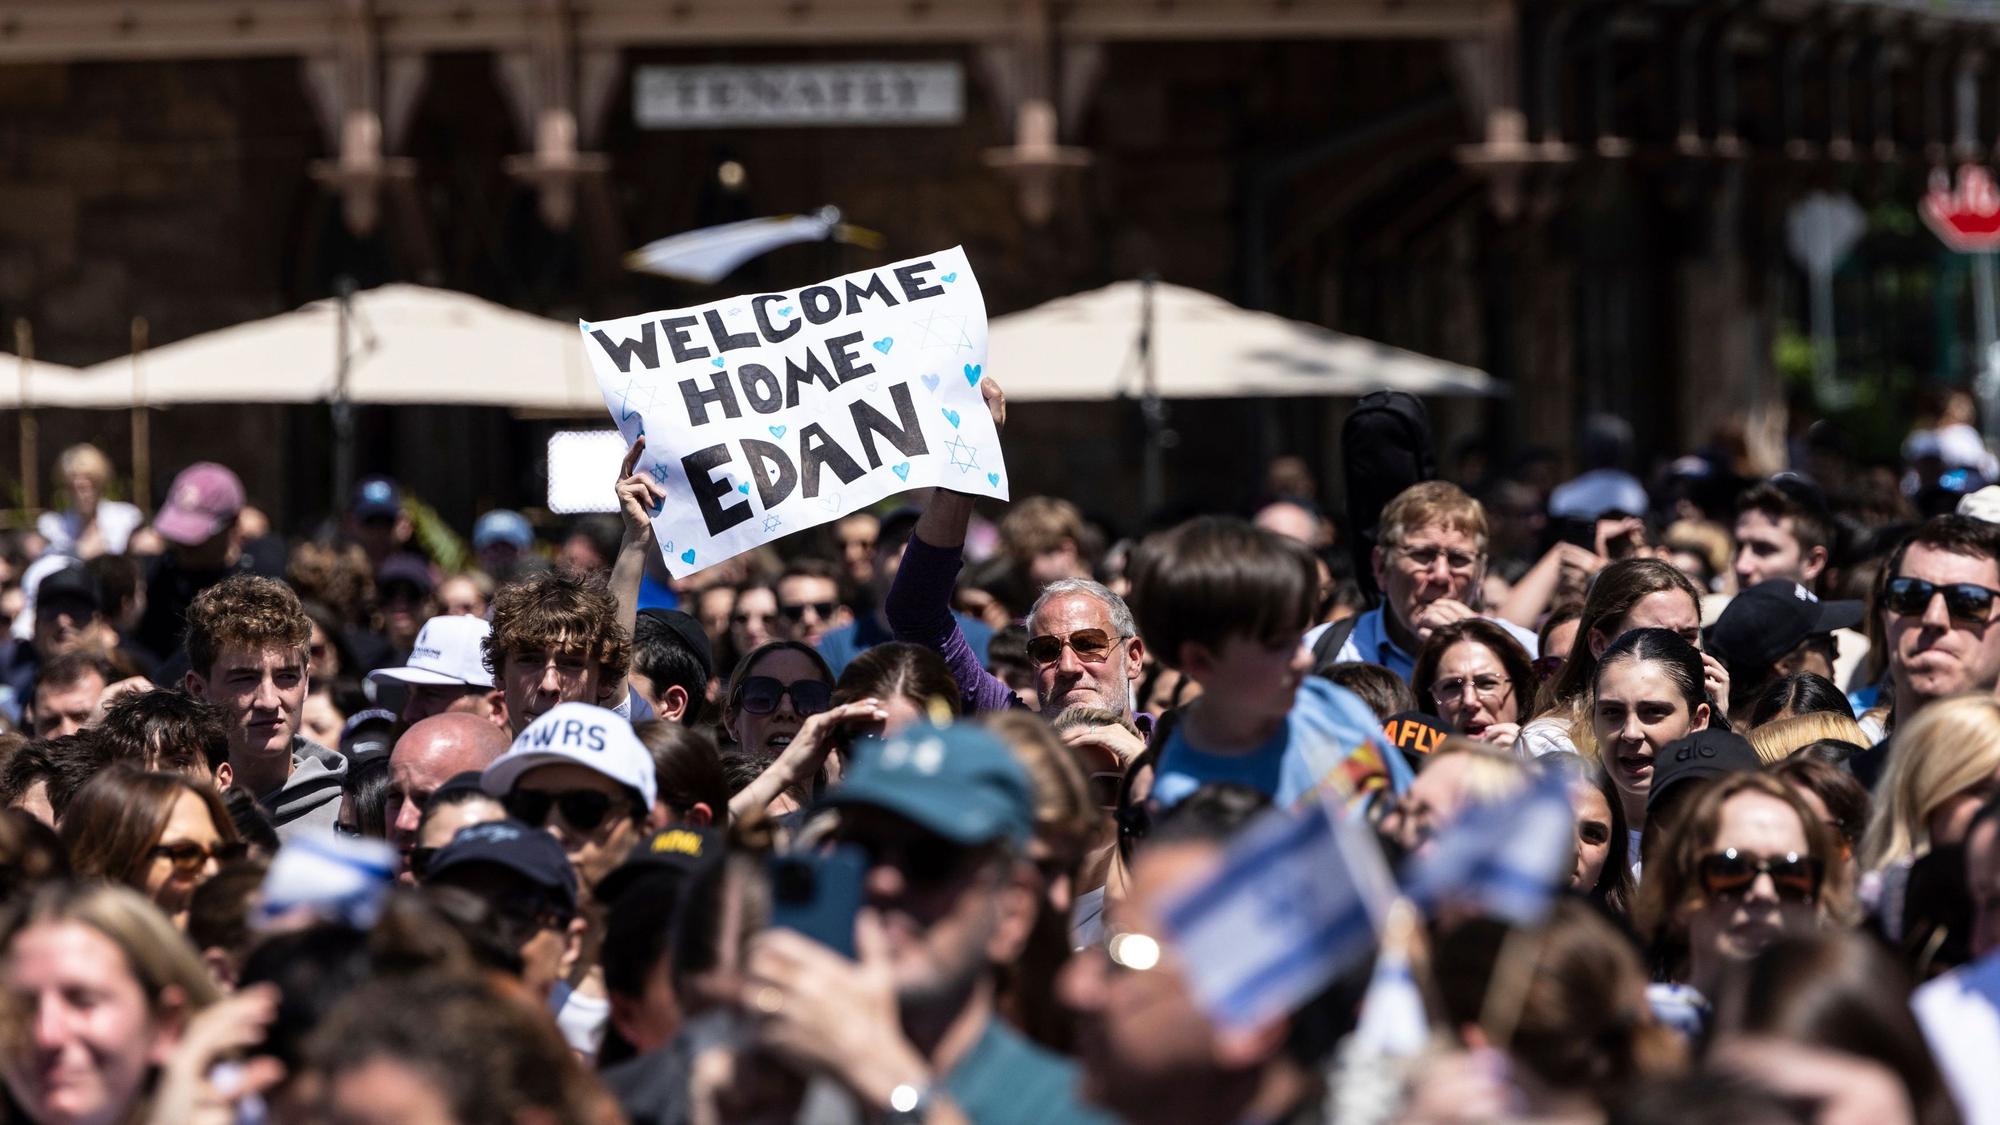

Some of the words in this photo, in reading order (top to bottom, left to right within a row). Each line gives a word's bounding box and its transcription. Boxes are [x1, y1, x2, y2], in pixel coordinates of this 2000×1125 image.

[673, 74, 918, 107] TENAFLY
[590, 261, 945, 373] WELCOME
[678, 331, 875, 427] HOME
[681, 382, 930, 537] EDAN
[1675, 738, 1718, 762] alo
